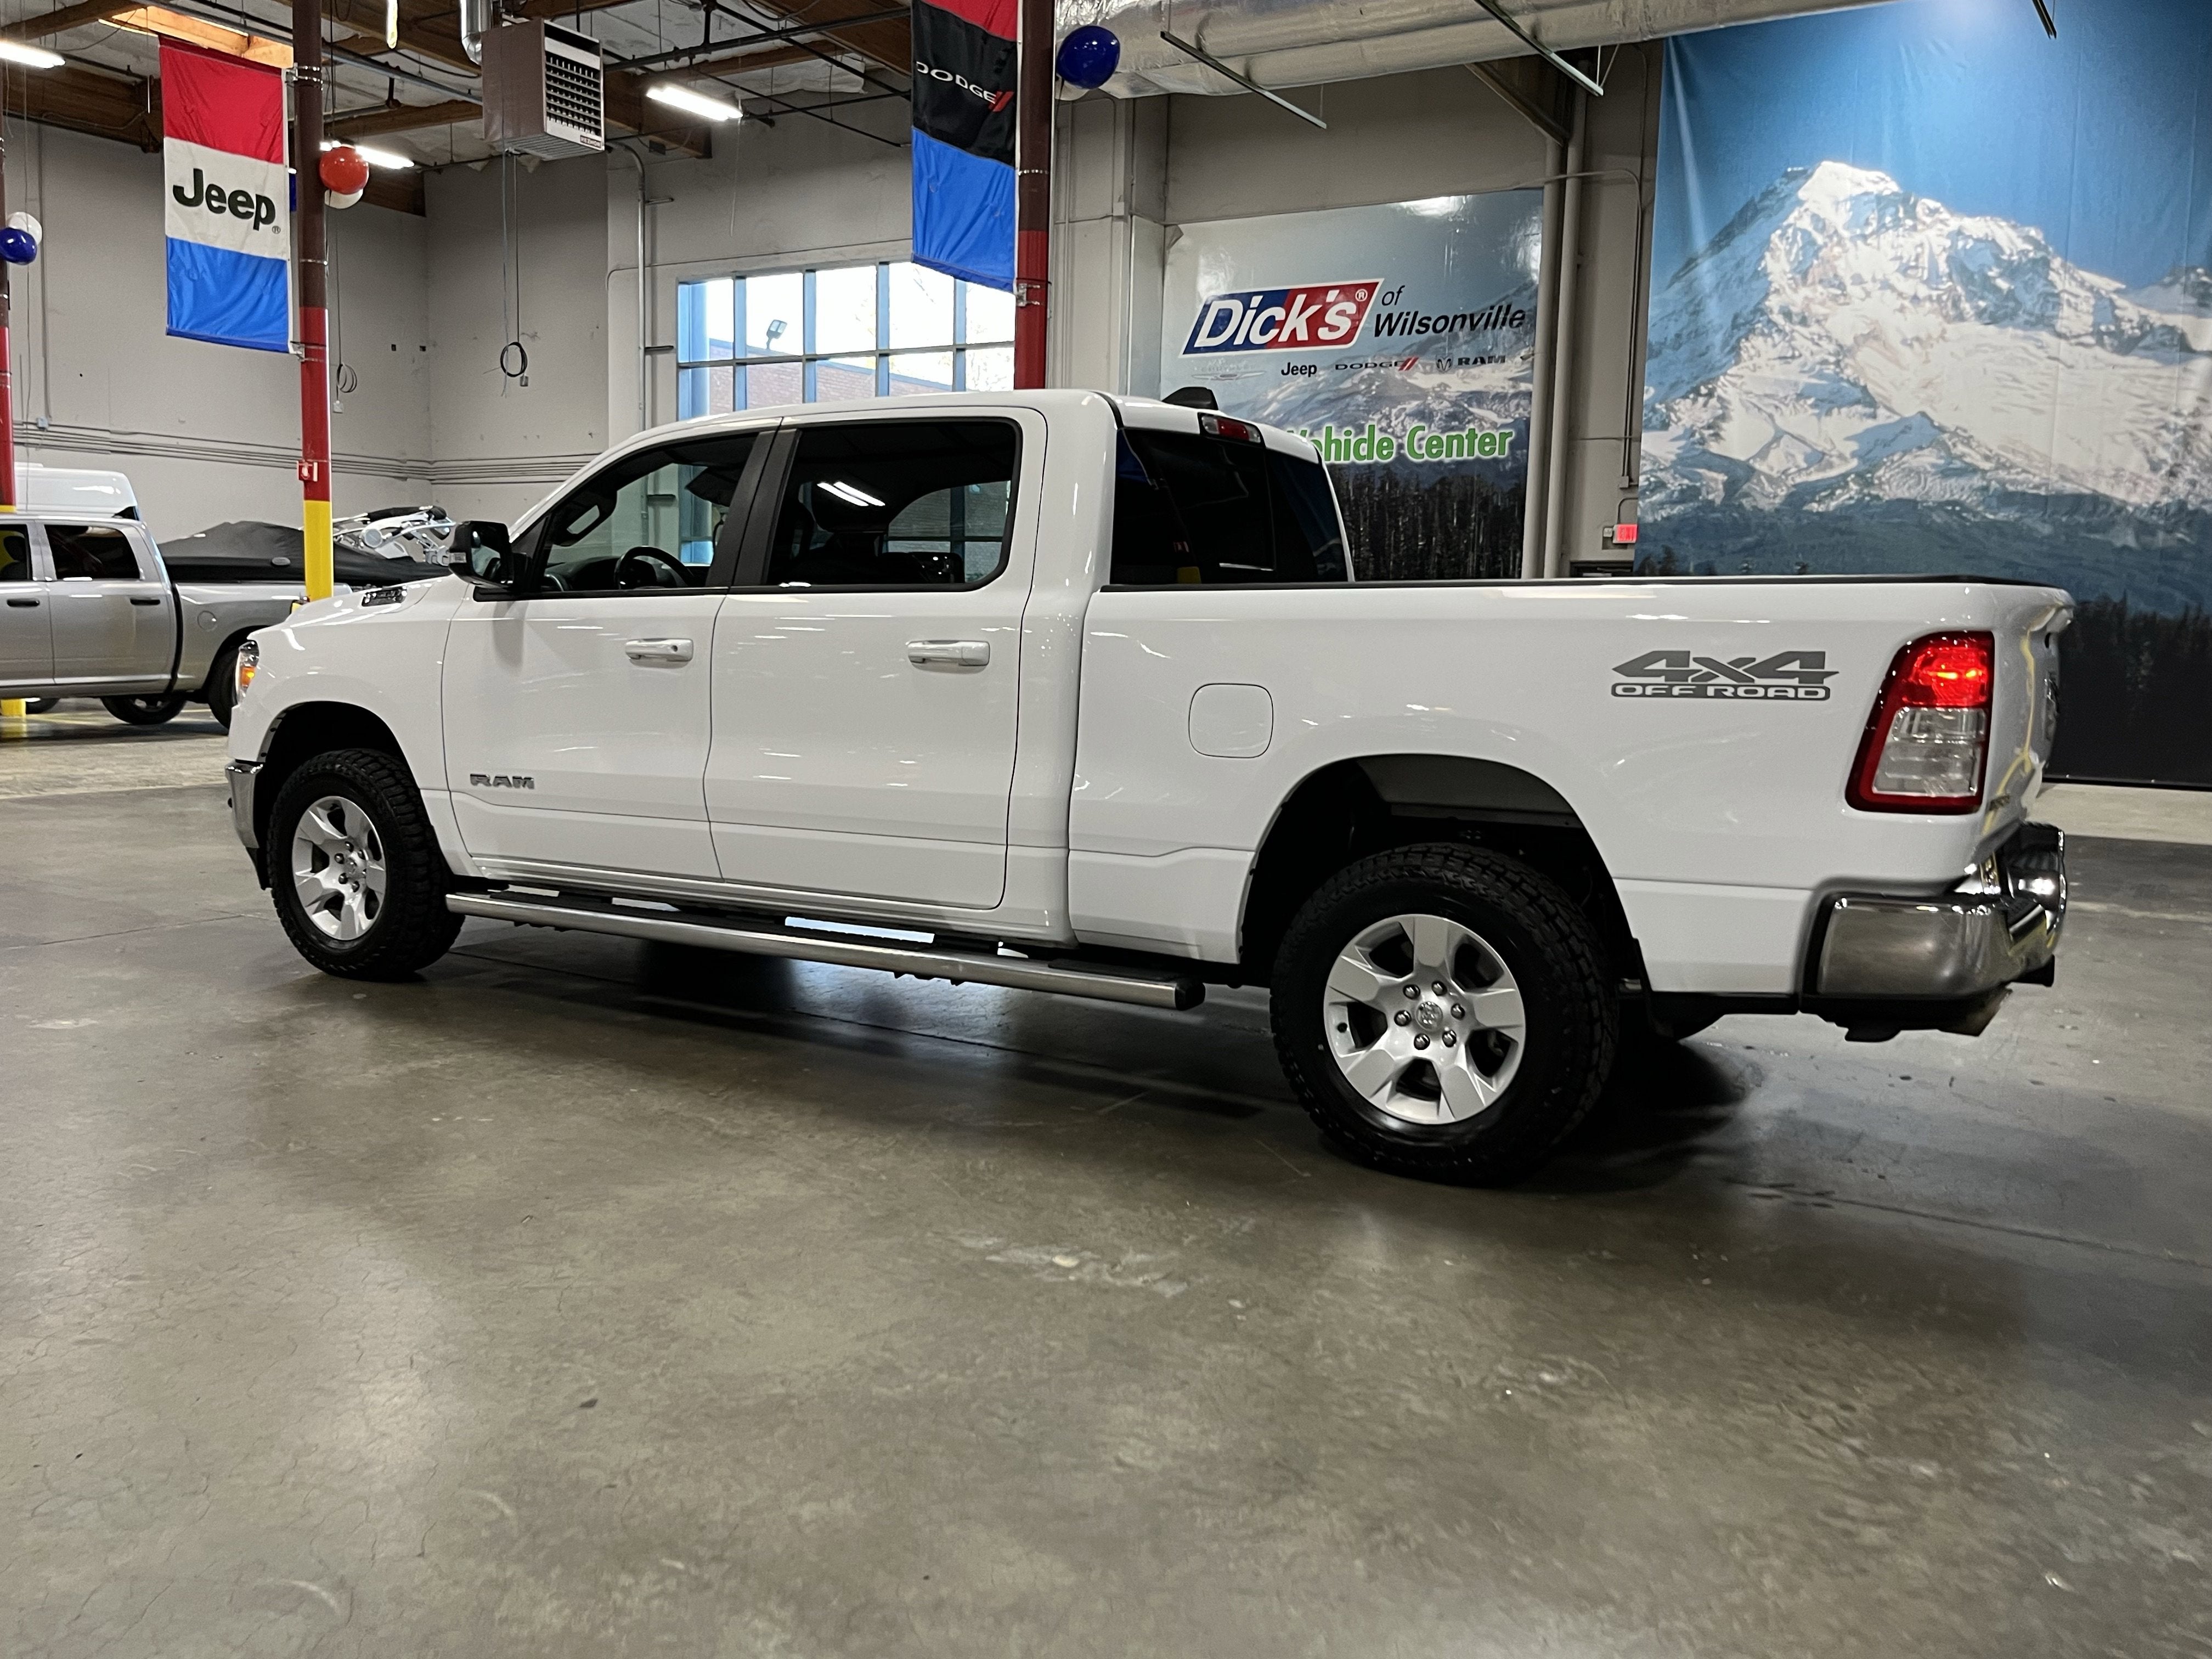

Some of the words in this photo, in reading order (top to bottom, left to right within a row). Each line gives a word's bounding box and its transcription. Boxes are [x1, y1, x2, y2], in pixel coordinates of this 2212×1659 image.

[916, 61, 997, 104] DODGE
[172, 168, 276, 231] Jeep
[1381, 285, 1406, 306] of
[1193, 289, 1357, 348] Dick's
[1374, 303, 1526, 337] Wilsonville
[1280, 362, 1317, 377] Jeep
[1335, 360, 1403, 370] DODGE
[1457, 355, 1506, 366] RAM
[1407, 425, 1513, 460] Center
[1615, 685, 1696, 696] OFF
[1706, 685, 1826, 699] ROAD
[470, 773, 535, 790] RAM
